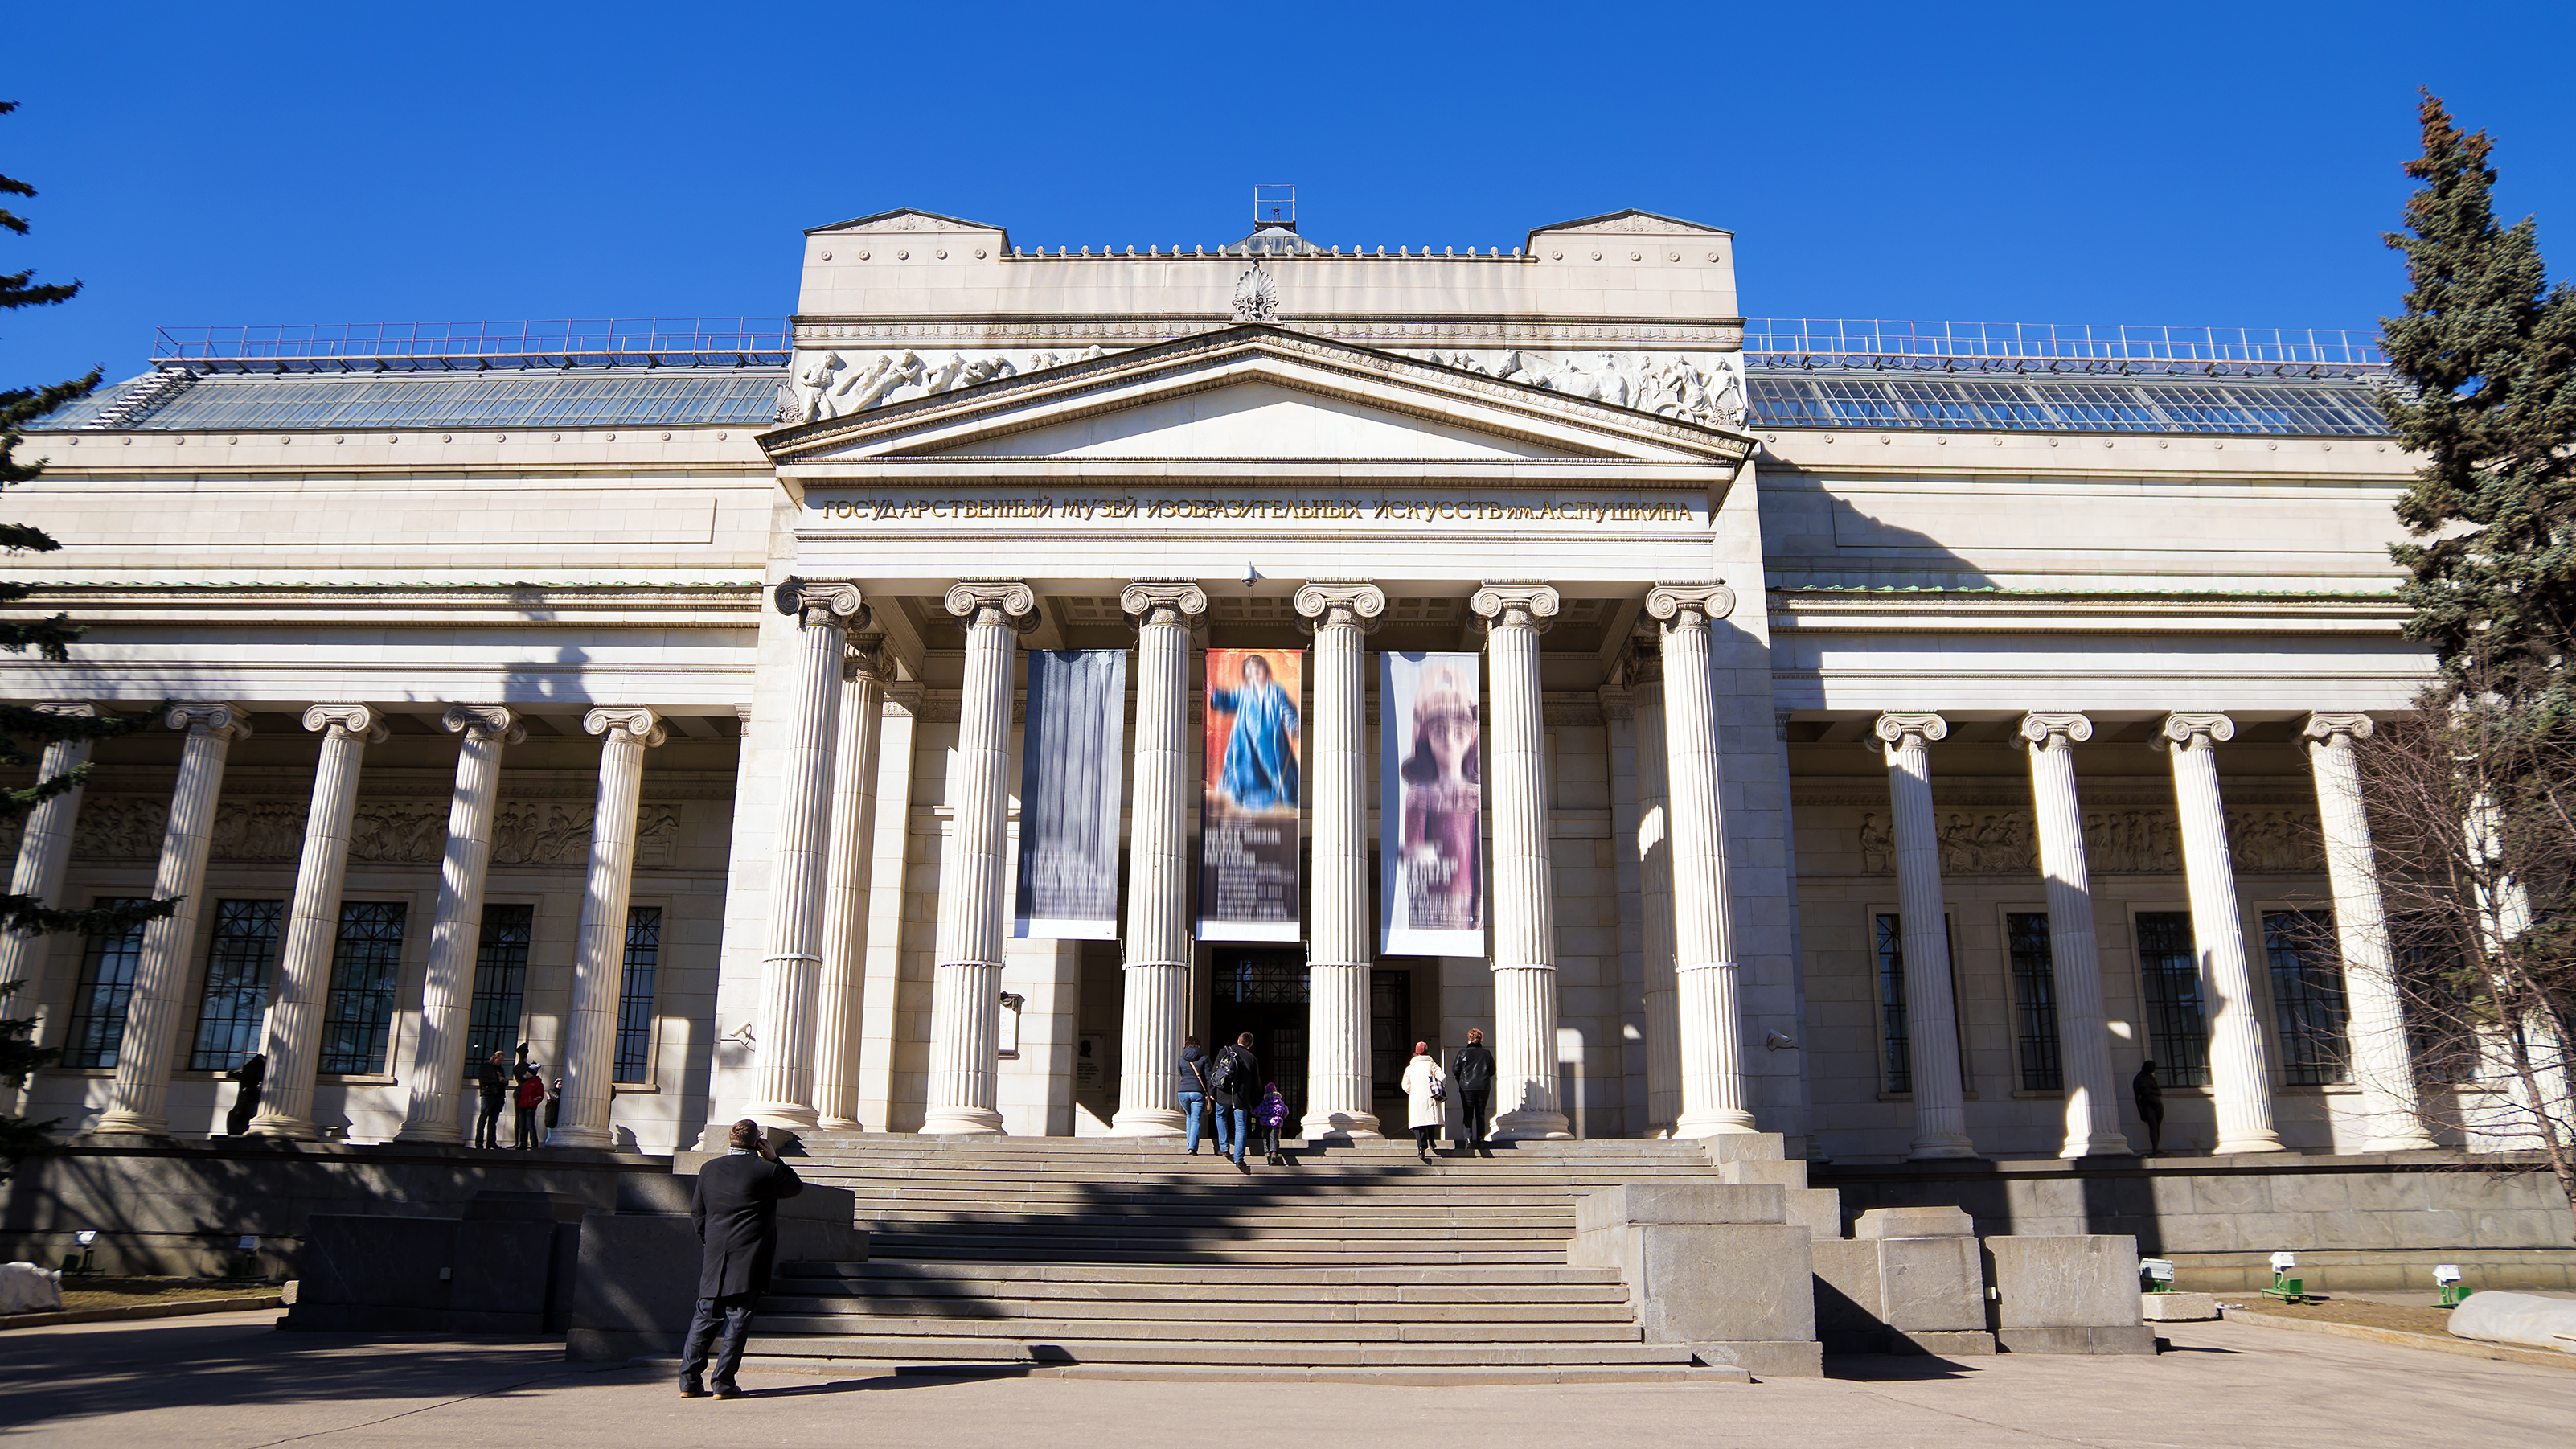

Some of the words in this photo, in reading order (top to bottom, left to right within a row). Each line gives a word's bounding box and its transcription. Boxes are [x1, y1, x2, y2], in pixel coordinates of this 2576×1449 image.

[822, 495, 1053, 521] ГОСУДАРСТВЕННЫЙ
[1060, 495, 1138, 521] МУЗЕЙ
[1146, 499, 1364, 519] ИЗОБРАЗИТЕЛЬНЫХ
[1372, 499, 1503, 523] ИСКУССТВ
